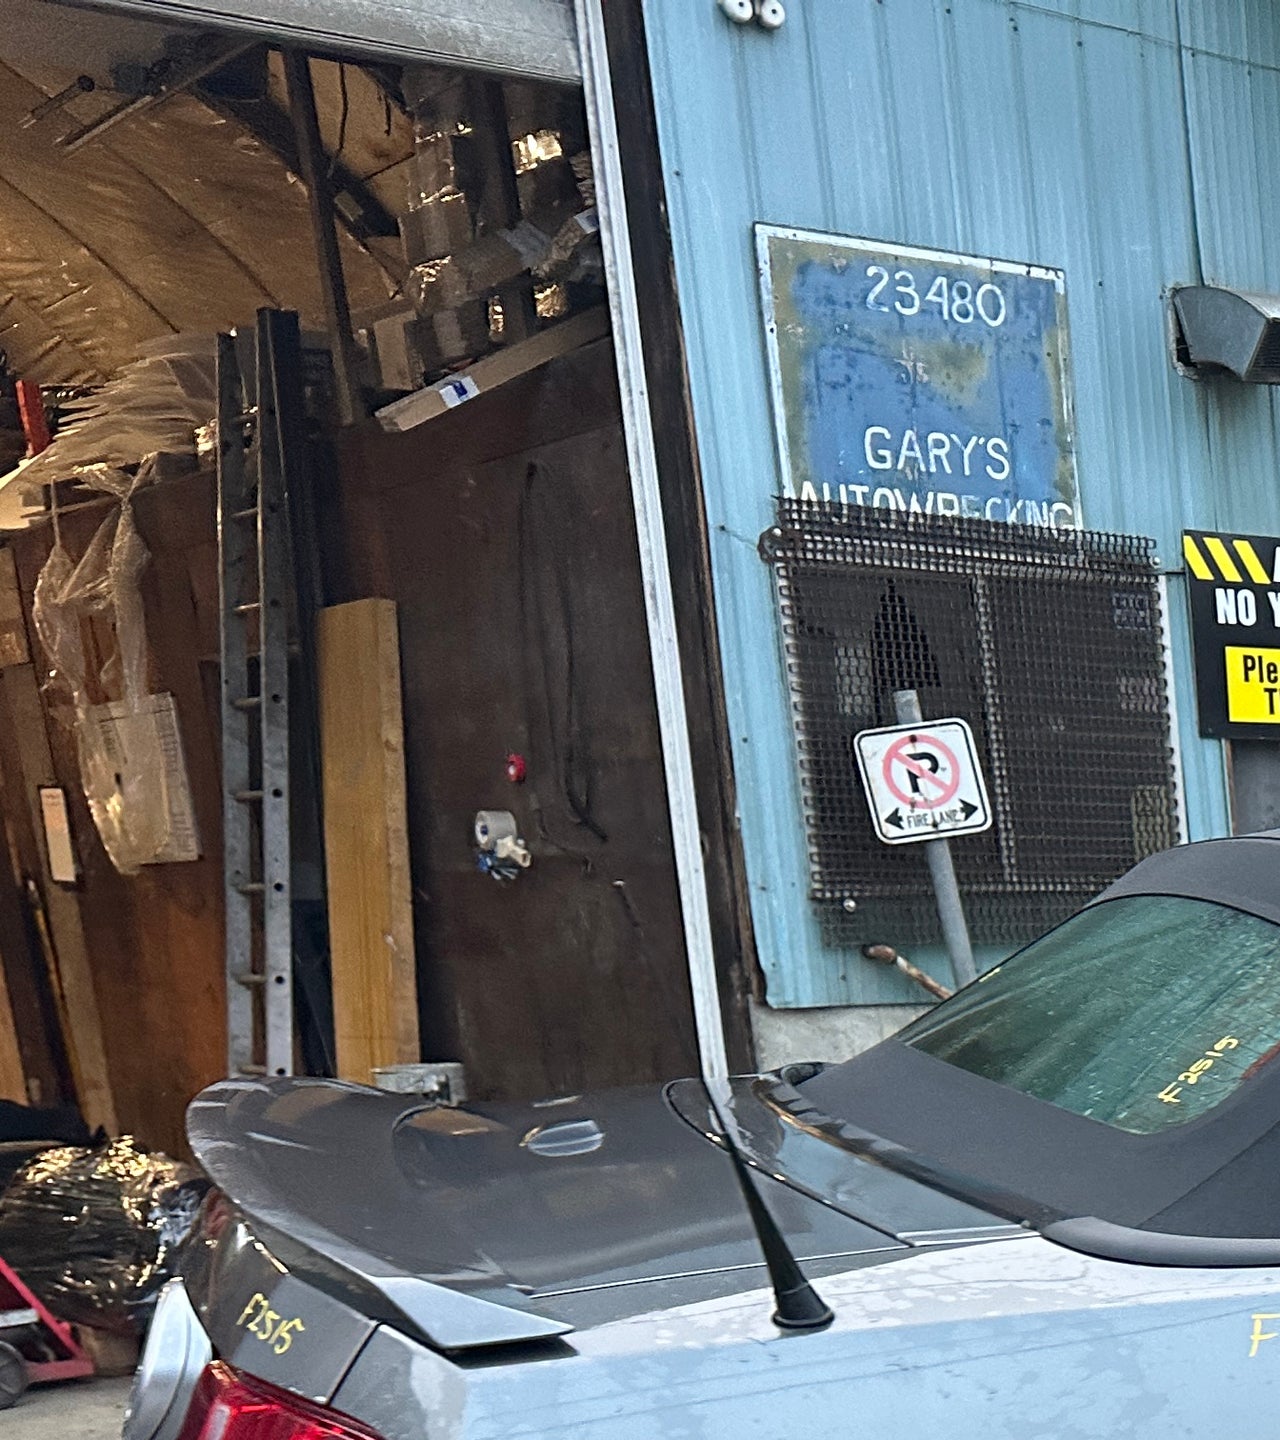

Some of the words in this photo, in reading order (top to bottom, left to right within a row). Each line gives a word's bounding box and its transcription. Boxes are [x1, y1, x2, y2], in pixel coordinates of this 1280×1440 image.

[865, 265, 1006, 328] 23480
[863, 425, 1010, 481] GARY'S
[1215, 588, 1257, 627] NO
[907, 813, 929, 829] FIRE
[236, 1292, 306, 1355] F2515
